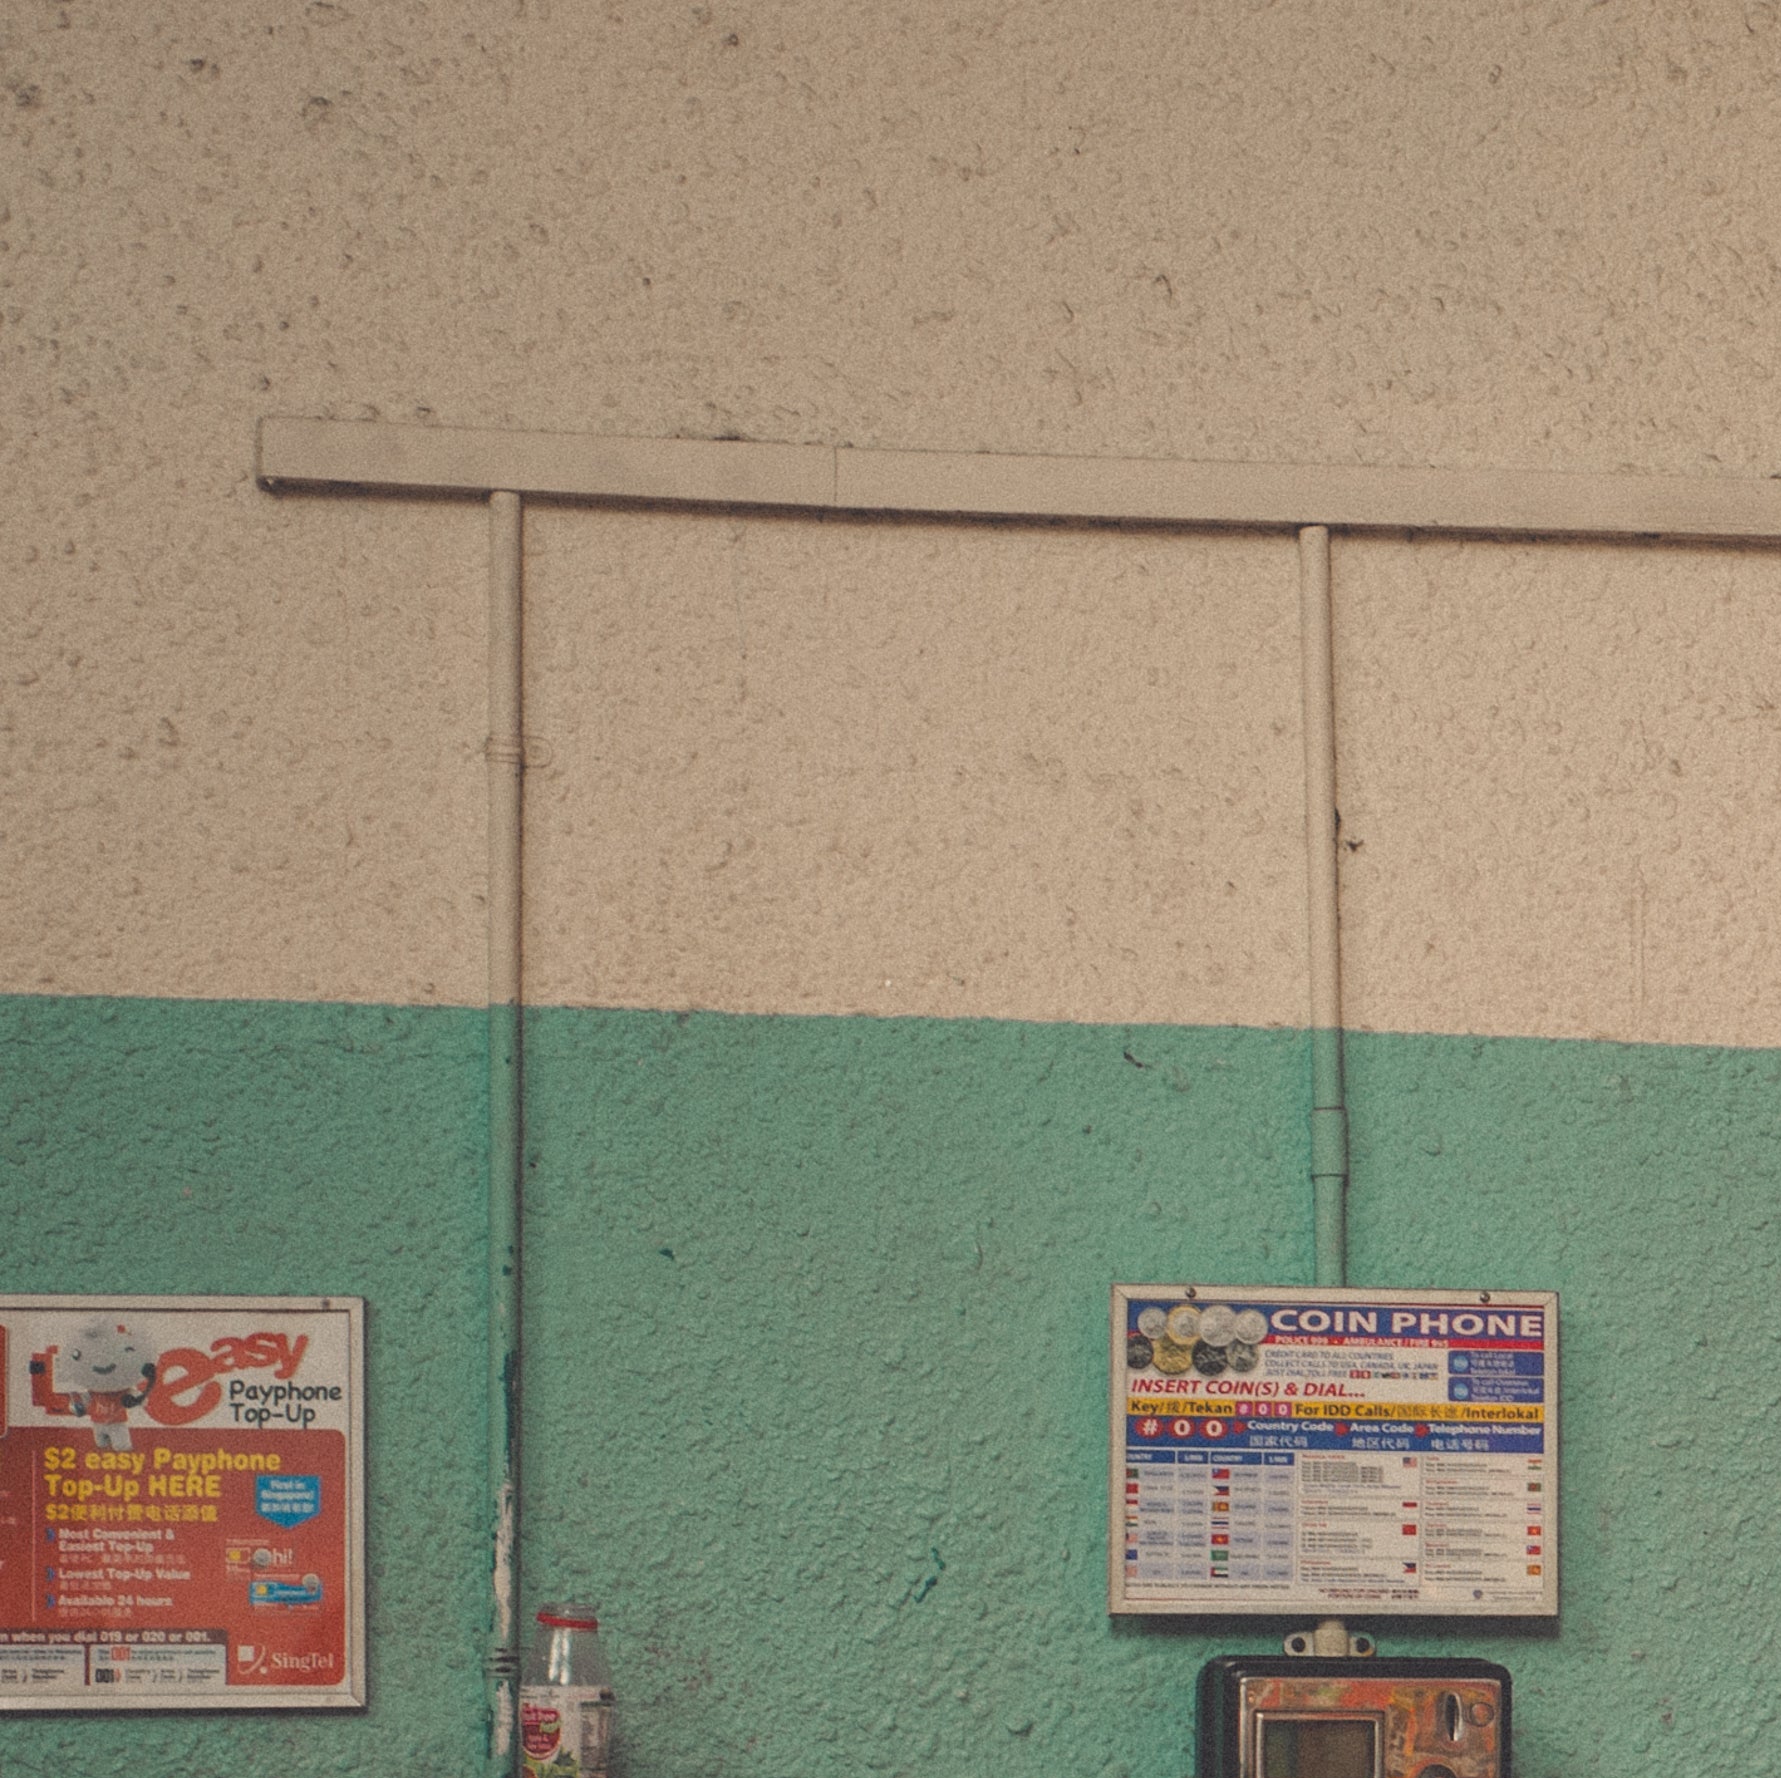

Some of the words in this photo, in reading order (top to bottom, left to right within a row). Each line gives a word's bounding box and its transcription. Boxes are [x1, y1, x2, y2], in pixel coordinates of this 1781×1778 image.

[1270, 1309, 1378, 1333] COIN
[1391, 1312, 1542, 1338] PHONE
[1275, 1336, 1309, 1345] POLICE
[1310, 1337, 1328, 1345] 999
[141, 1331, 309, 1426] easy
[229, 1379, 342, 1408] Payphone
[1131, 1379, 1201, 1394] INSERT
[1206, 1380, 1279, 1397] COIN(S)
[1283, 1382, 1298, 1396] &
[1303, 1383, 1366, 1398] DIAL...
[229, 1402, 316, 1429] Top-Up
[1295, 1403, 1319, 1416] For
[1324, 1404, 1350, 1417] IDD
[1142, 1418, 1158, 1436] #
[1174, 1419, 1191, 1436] 0
[1206, 1419, 1223, 1437] 0
[1247, 1420, 1298, 1433] Country
[1301, 1420, 1334, 1432] Code
[1350, 1422, 1379, 1433] Area
[1381, 1422, 1414, 1434] Code
[1428, 1423, 1491, 1437] Telephone
[1492, 1424, 1541, 1435] Number
[1250, 1435, 1308, 1447] 国家代码
[1352, 1437, 1410, 1450] 地区代码
[1431, 1438, 1489, 1450] 电话号码
[44, 1446, 77, 1470] $2
[85, 1452, 145, 1475] easy
[154, 1448, 281, 1474] Payphone
[44, 1474, 139, 1501] Top-Up
[149, 1475, 222, 1498] HERE
[108, 1540, 154, 1554] Top-Up
[273, 1549, 294, 1566] hi!
[58, 1569, 104, 1580] Lowest
[106, 1569, 152, 1582] Top-Up
[156, 1569, 190, 1580] Value
[58, 1595, 115, 1606] Available
[137, 1595, 173, 1607] hours
[12, 1632, 46, 1642] when
[48, 1633, 71, 1644] you
[73, 1631, 98, 1642] dial
[125, 1632, 139, 1642] or
[141, 1631, 166, 1642] 020
[169, 1632, 182, 1642] or
[271, 1652, 334, 1671] SingTel
